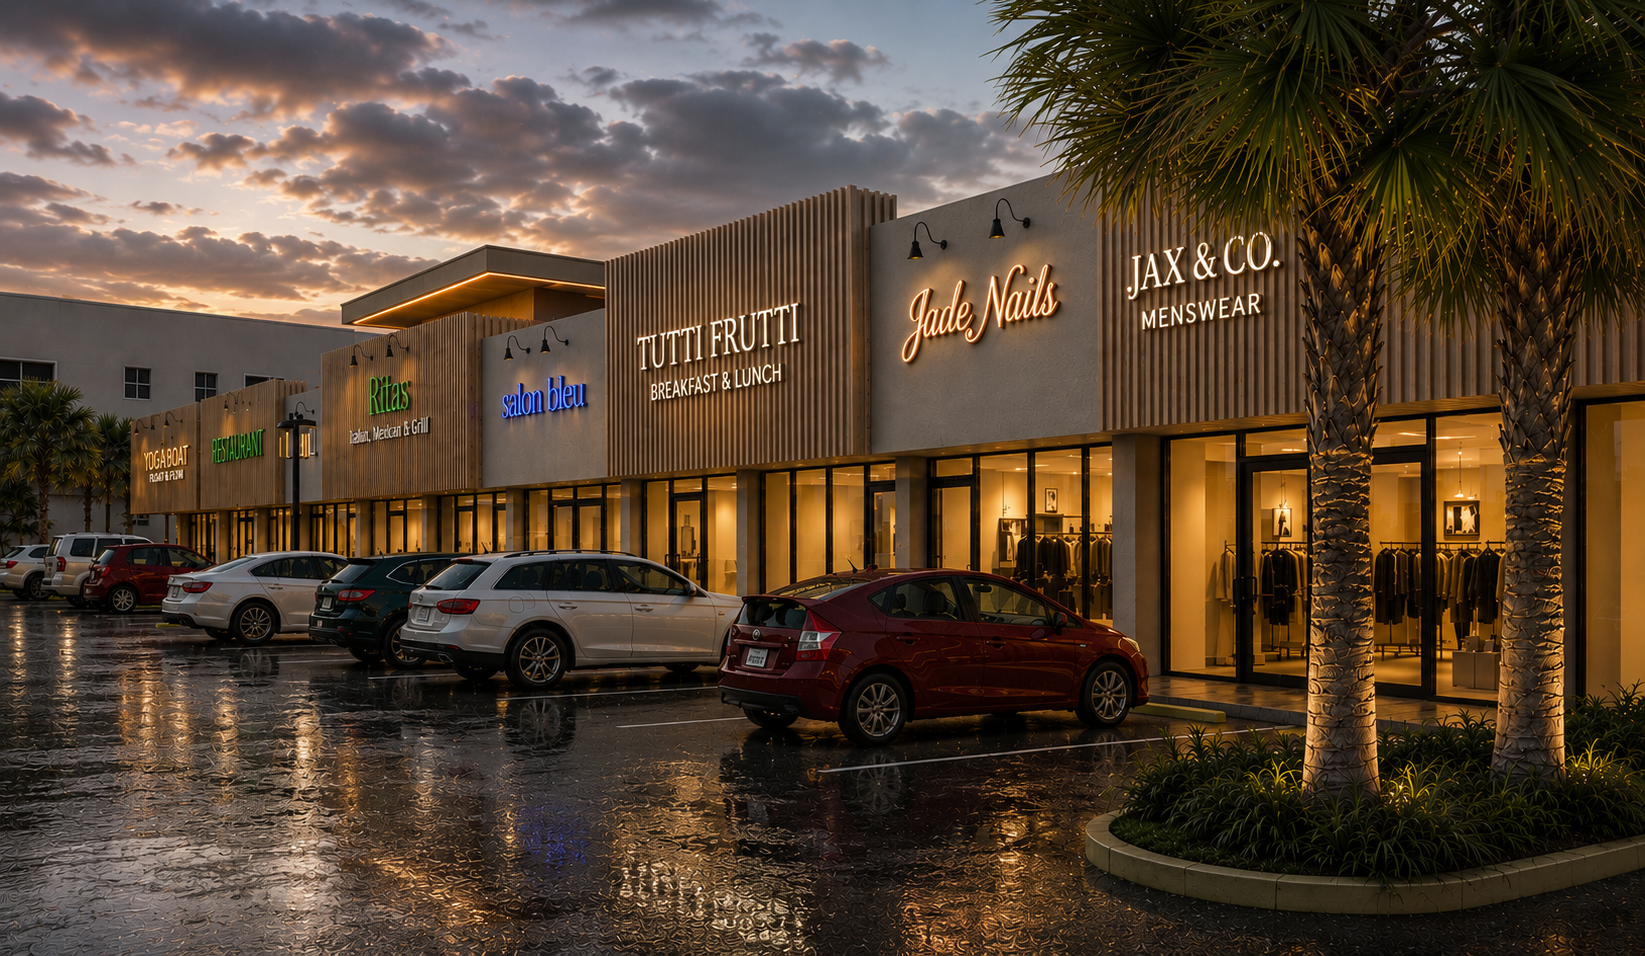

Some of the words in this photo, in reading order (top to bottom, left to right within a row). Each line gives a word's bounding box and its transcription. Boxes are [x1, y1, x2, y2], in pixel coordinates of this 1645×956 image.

[1127, 246, 1186, 300] JAX
[1193, 242, 1218, 281] &
[1223, 231, 1281, 276] CO.
[901, 279, 974, 363] Jade
[965, 263, 1059, 344] Nails
[1142, 293, 1262, 331] MENSWEAR
[637, 324, 703, 371] TUTTI
[710, 302, 800, 358] FRUTTI
[369, 376, 409, 415] Ritas
[502, 383, 544, 418] salon
[548, 375, 586, 411] bleu
[651, 372, 719, 401] BREAKFAST
[722, 371, 732, 390] &
[735, 363, 782, 388] LUNCH
[404, 420, 411, 436] &
[412, 416, 430, 435] Grill
[212, 429, 264, 464] RESTAURANT
